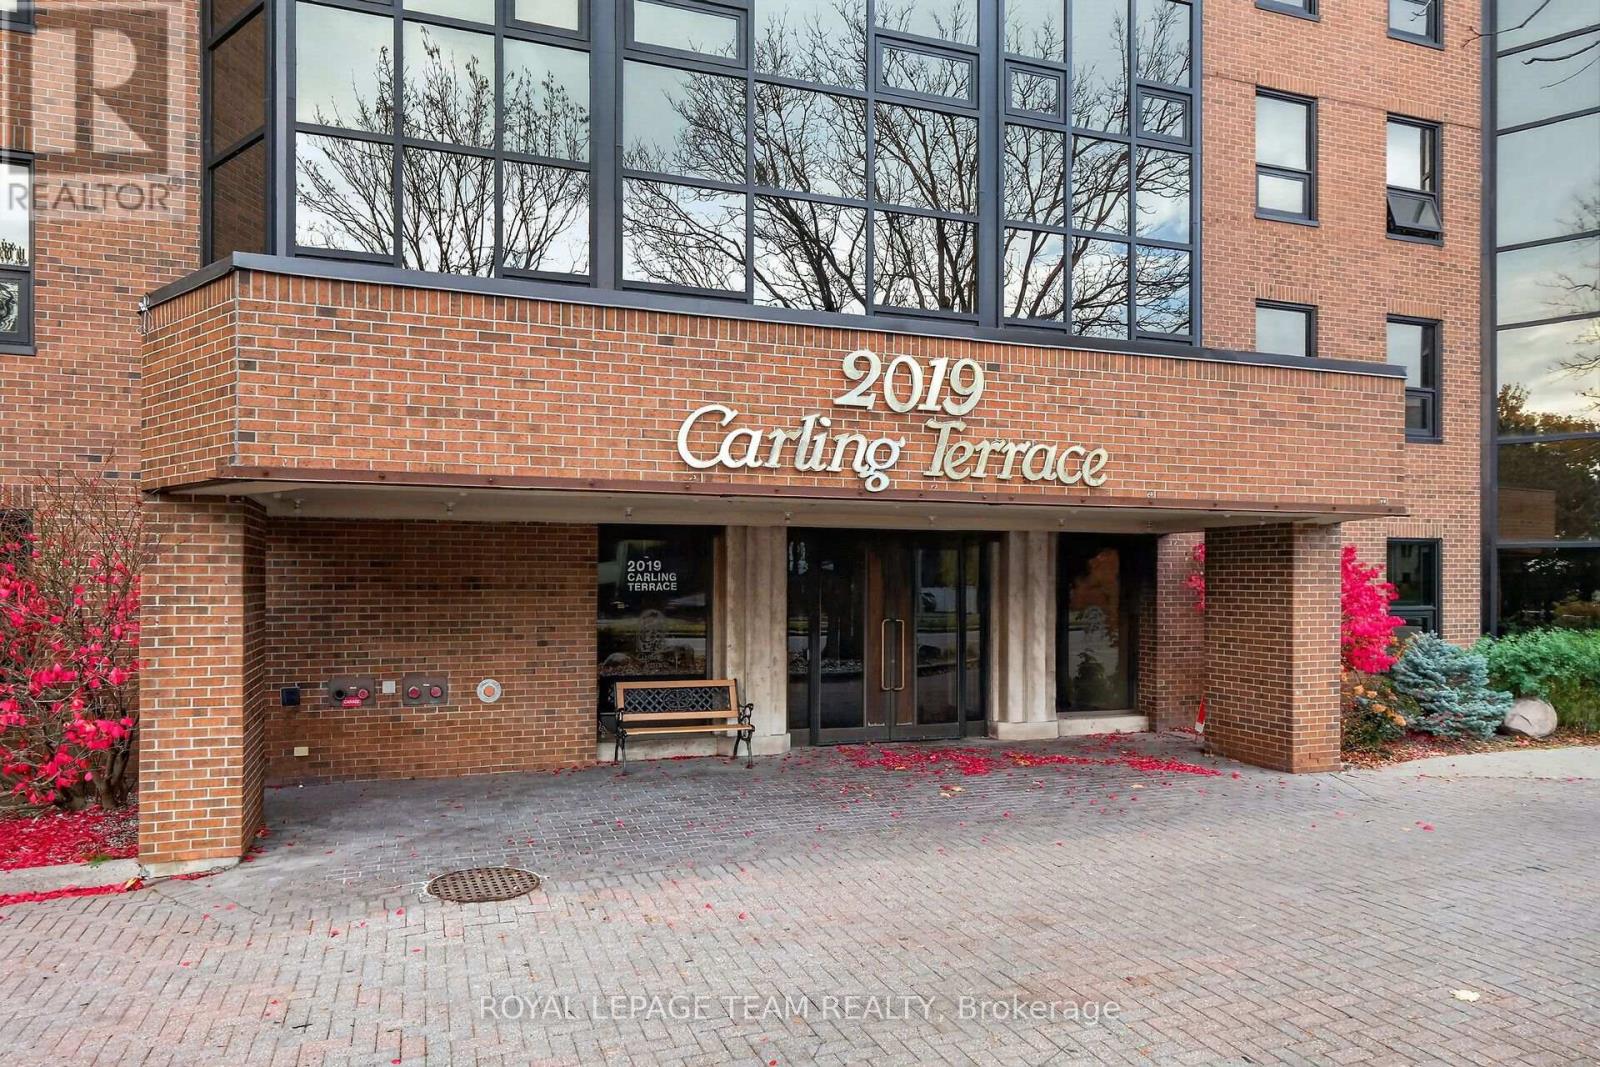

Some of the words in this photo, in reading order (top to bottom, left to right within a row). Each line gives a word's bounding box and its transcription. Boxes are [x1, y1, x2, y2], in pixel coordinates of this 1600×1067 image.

[833, 349, 986, 416] 2019
[677, 403, 906, 493] Carling
[923, 417, 1109, 487] Terrace
[627, 560, 662, 571] 2019
[627, 572, 677, 582] CARLING
[627, 582, 677, 591] TERRACE
